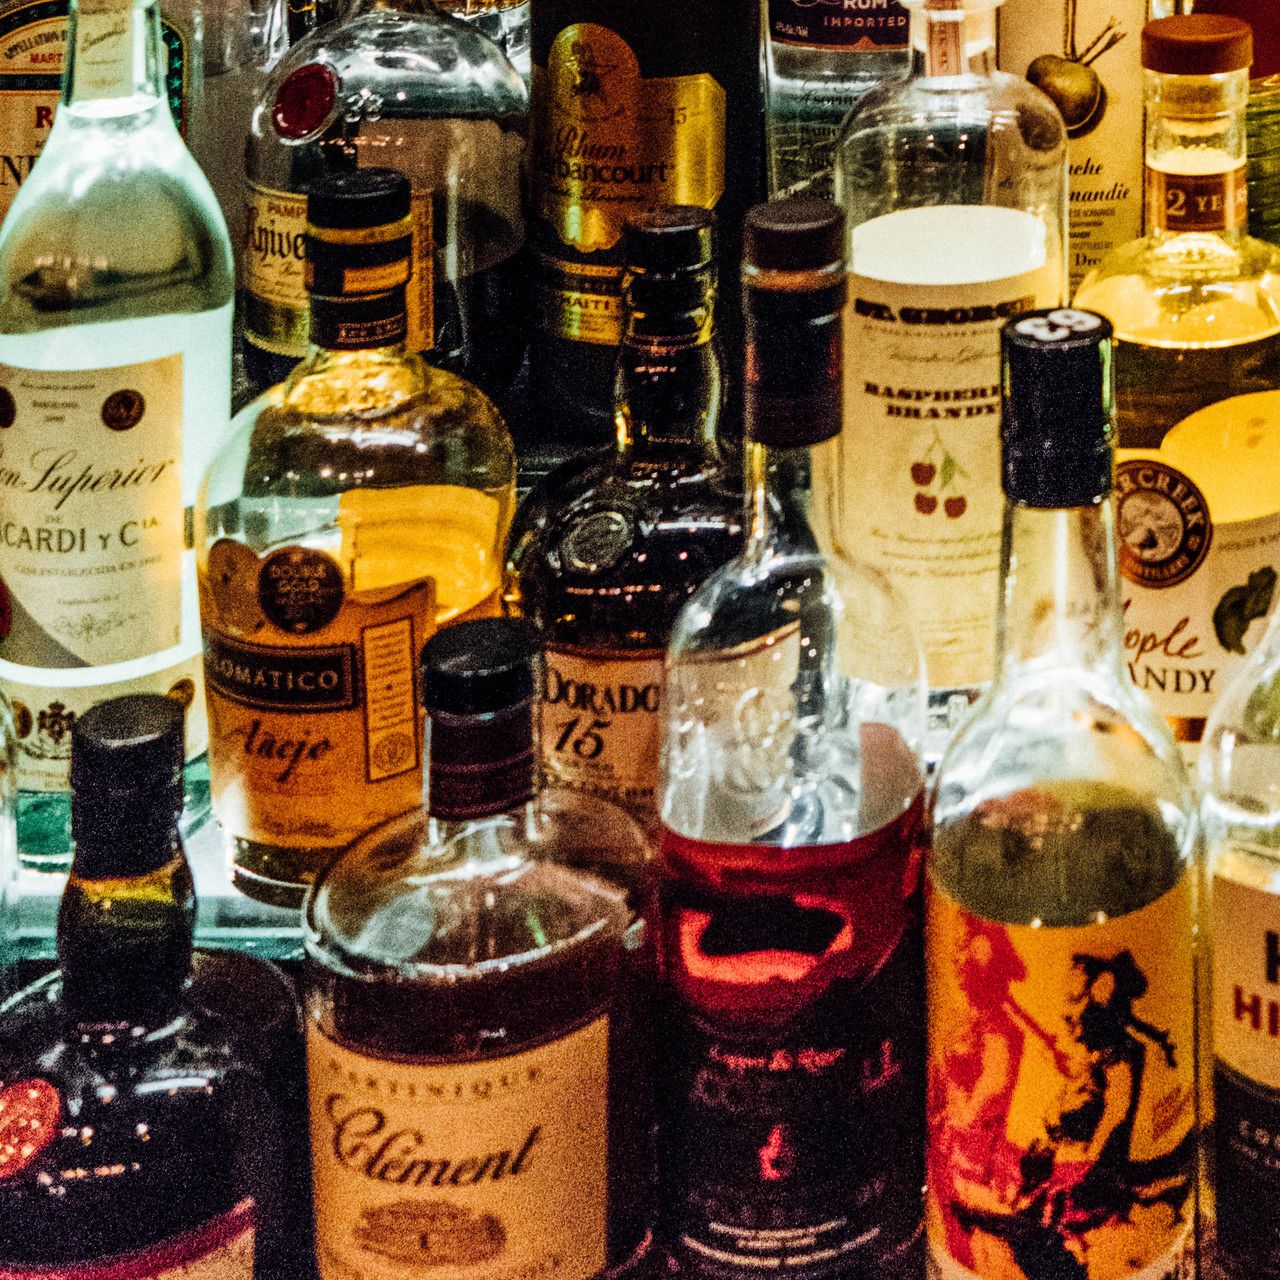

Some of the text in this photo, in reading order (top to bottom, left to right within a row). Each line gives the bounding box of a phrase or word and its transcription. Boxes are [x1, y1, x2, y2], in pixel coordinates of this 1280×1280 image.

[824, 16, 906, 27] IMPORTED
[25, 447, 175, 510] Superior
[45, 515, 61, 525] DE
[4, 523, 112, 554] CARDI Y
[217, 659, 339, 690] OMATICO
[1128, 662, 1216, 694] NDY
[547, 668, 660, 716] DORADO
[555, 716, 612, 759] 15
